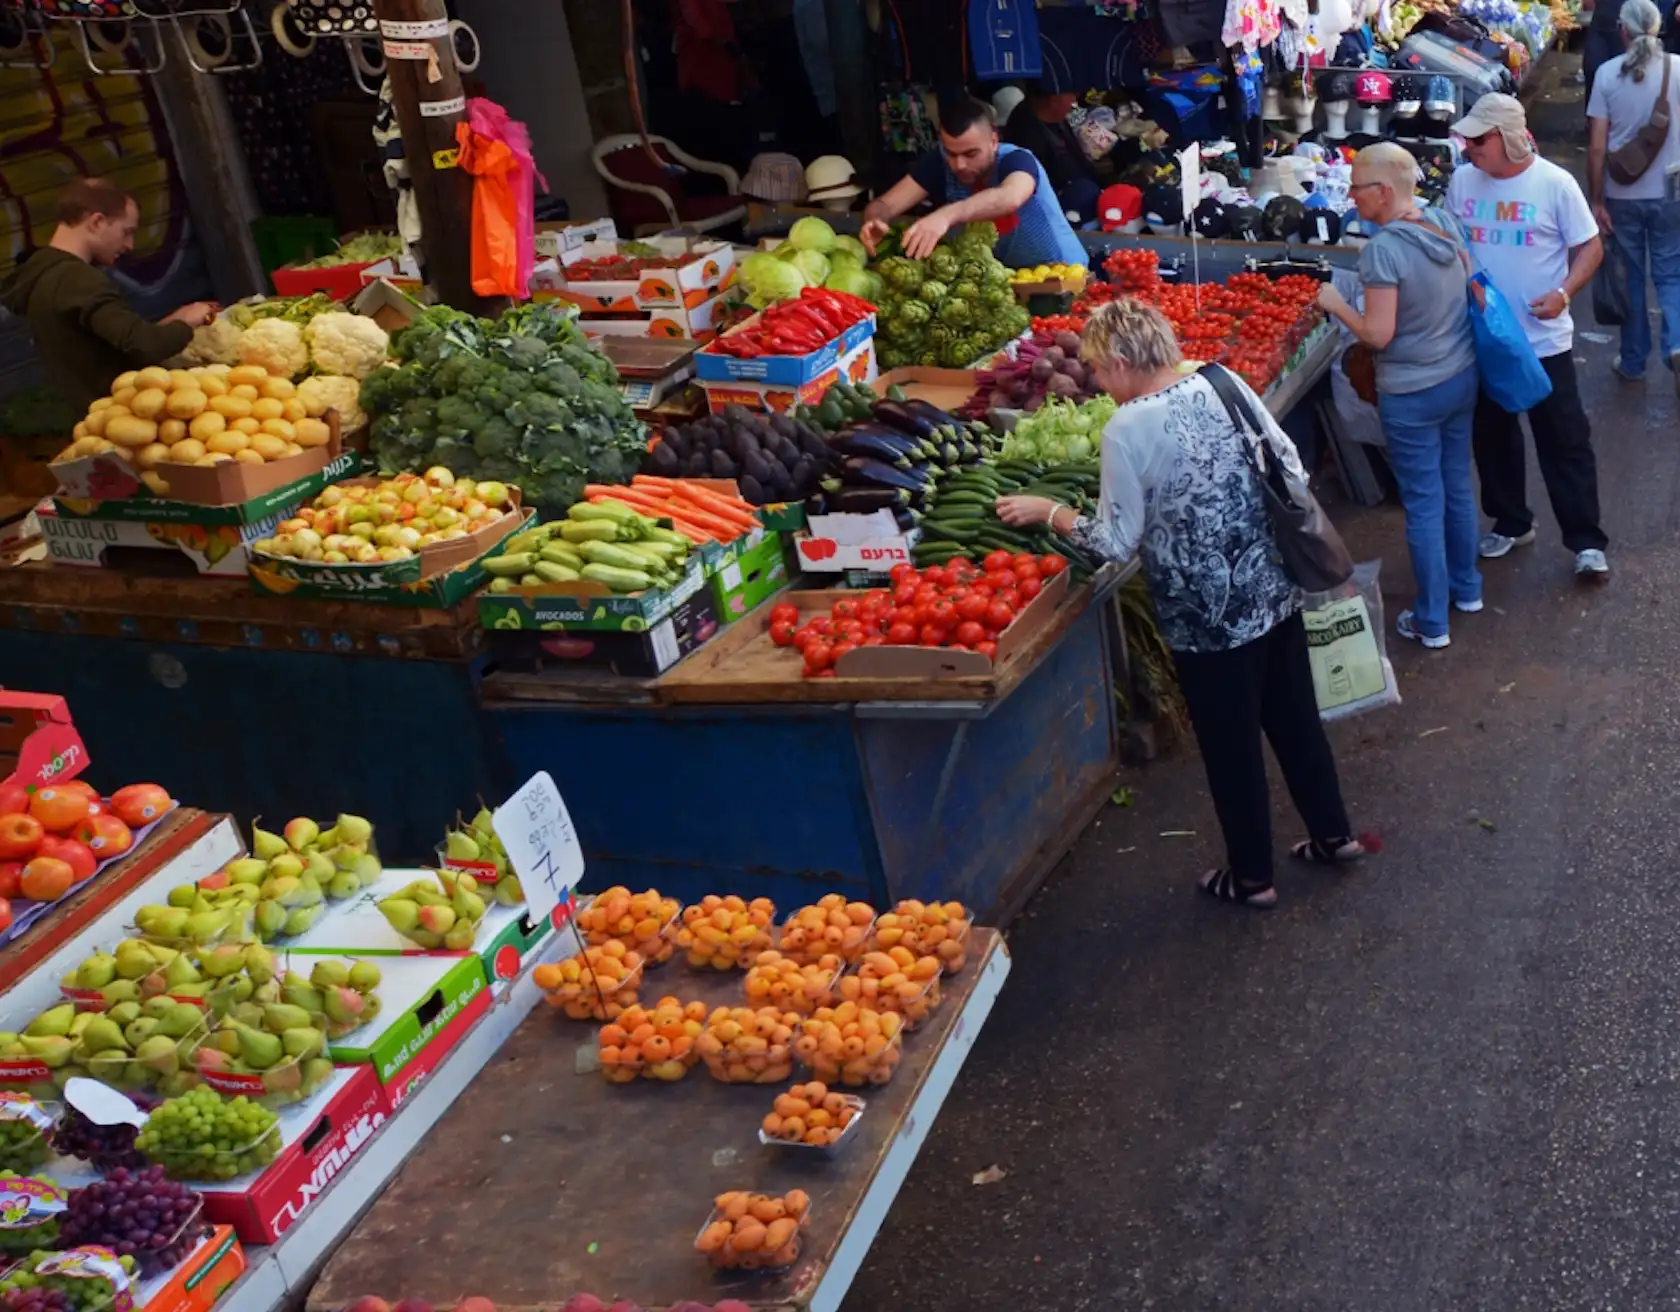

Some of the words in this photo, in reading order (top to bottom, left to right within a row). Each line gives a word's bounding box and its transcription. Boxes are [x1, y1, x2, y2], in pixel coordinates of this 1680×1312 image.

[860, 549, 906, 560] ברעם
[534, 611, 585, 622] AVOCADOS
[271, 1111, 386, 1237] בראשית
